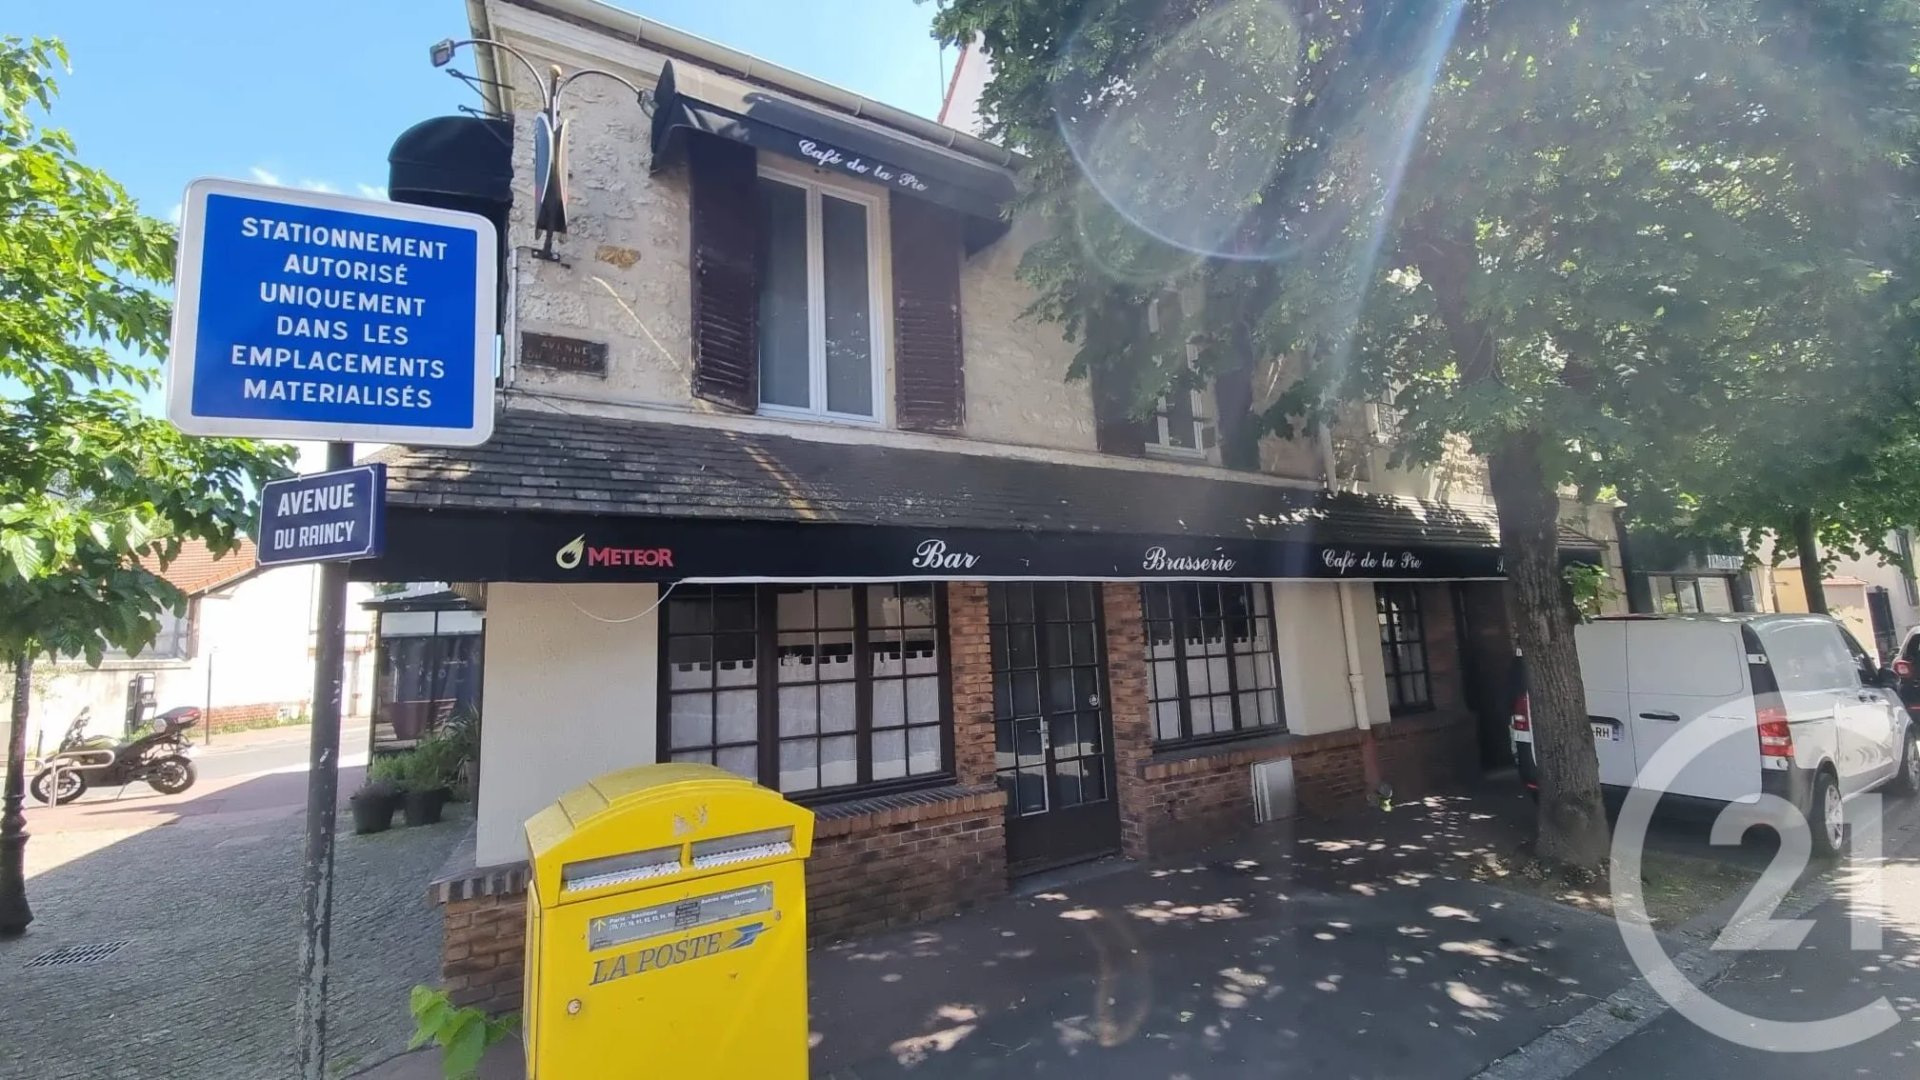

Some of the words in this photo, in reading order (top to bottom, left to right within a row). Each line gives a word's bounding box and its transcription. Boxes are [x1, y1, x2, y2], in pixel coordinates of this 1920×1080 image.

[799, 139, 843, 166] Café
[846, 158, 870, 174] de
[873, 165, 894, 181] la
[898, 172, 928, 192] Pie
[241, 217, 448, 260] STATIONNEMENT
[283, 254, 408, 286] AUTORISÉ
[260, 282, 426, 317] UNIQUEMENT
[276, 316, 349, 341] DANS
[363, 323, 409, 346] LES
[231, 345, 445, 379] EMPLACEMENTS
[243, 378, 432, 409] MATERIALISÉS
[277, 483, 356, 517] AVENUE
[273, 527, 296, 551] DU
[298, 520, 356, 548] RAINCY
[587, 546, 674, 568] METEOR
[912, 538, 981, 569] Bar
[1142, 545, 1237, 571] Brasserie
[1322, 548, 1357, 575] Café
[1360, 551, 1378, 568] de
[1382, 551, 1396, 568] la
[1400, 551, 1422, 569] Pie
[589, 955, 628, 986] LA
[635, 932, 722, 969] POSTE
